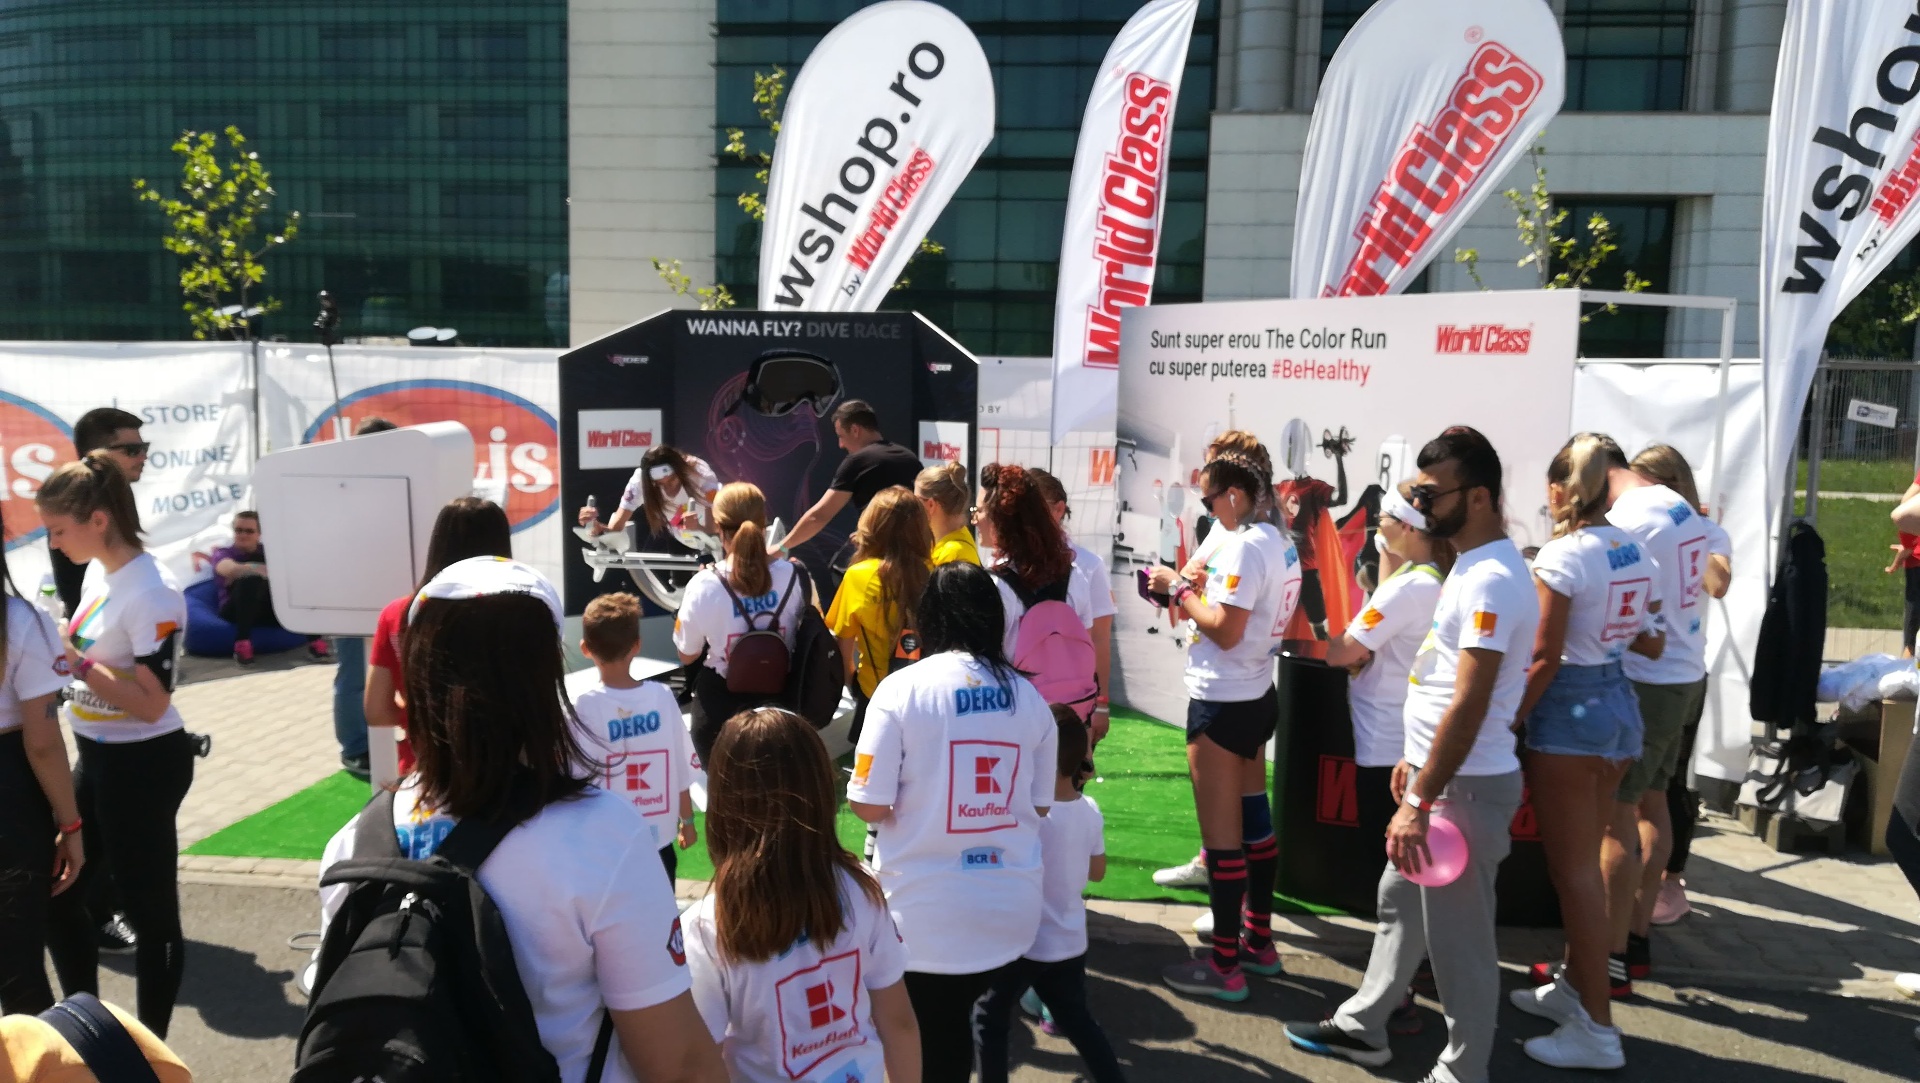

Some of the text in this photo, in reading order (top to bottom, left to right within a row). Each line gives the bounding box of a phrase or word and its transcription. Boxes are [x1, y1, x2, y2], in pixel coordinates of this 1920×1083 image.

[1103, 75, 1171, 219] Class
[774, 41, 945, 310] wshop.ro
[1322, 46, 1537, 297] orld Class
[840, 149, 936, 297] by World Class
[686, 319, 901, 339] WANNA FLY? DIVE RACE
[1150, 327, 1387, 354] Sunt super erou The Color Run
[1436, 324, 1531, 354] World Class
[1149, 359, 1371, 387] cu super puterea #BeHealthy
[141, 404, 220, 424] STORE
[150, 445, 231, 469] ONLINE
[152, 484, 242, 515] MOBILE
[955, 684, 1010, 717] DERO
[607, 710, 661, 743] DERO
[957, 801, 1010, 818] Kauflan
[396, 818, 458, 860] DER
[967, 853, 988, 865] BCR
[791, 1024, 859, 1059] Kauflan
